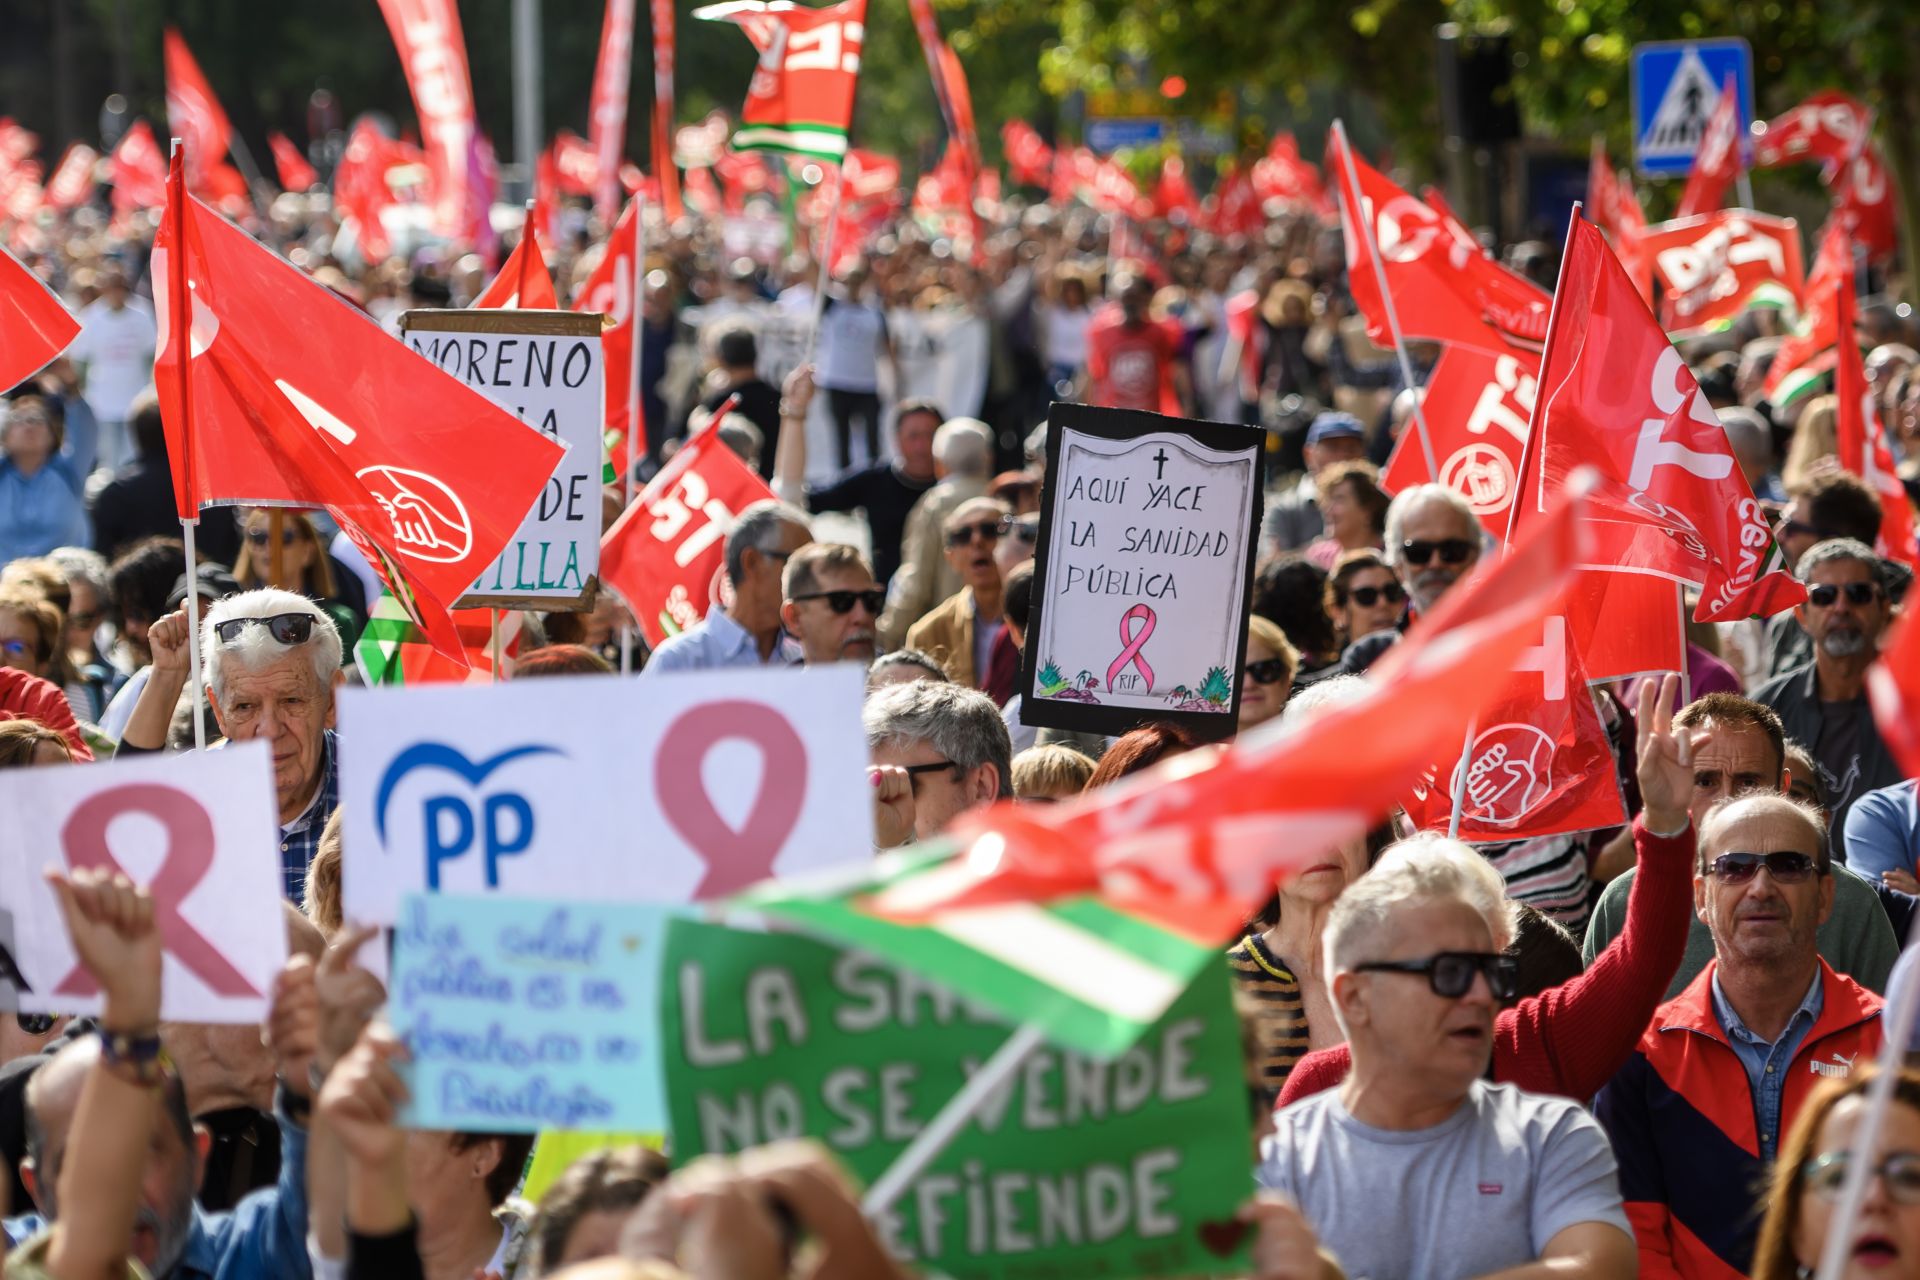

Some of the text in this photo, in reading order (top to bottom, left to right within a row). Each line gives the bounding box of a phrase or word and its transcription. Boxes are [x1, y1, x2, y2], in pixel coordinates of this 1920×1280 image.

[412, 338, 592, 388] MORENO
[538, 475, 588, 522] DE
[1067, 476, 1208, 511] AQUÍ YACE
[1071, 521, 1096, 548] LA
[490, 541, 585, 591] ILLA
[1119, 674, 1141, 690] RIP
[680, 960, 807, 1067] LA
[1810, 1060, 1848, 1078] PUMA
[697, 1082, 803, 1152] NO
[822, 1065, 925, 1149] SE
